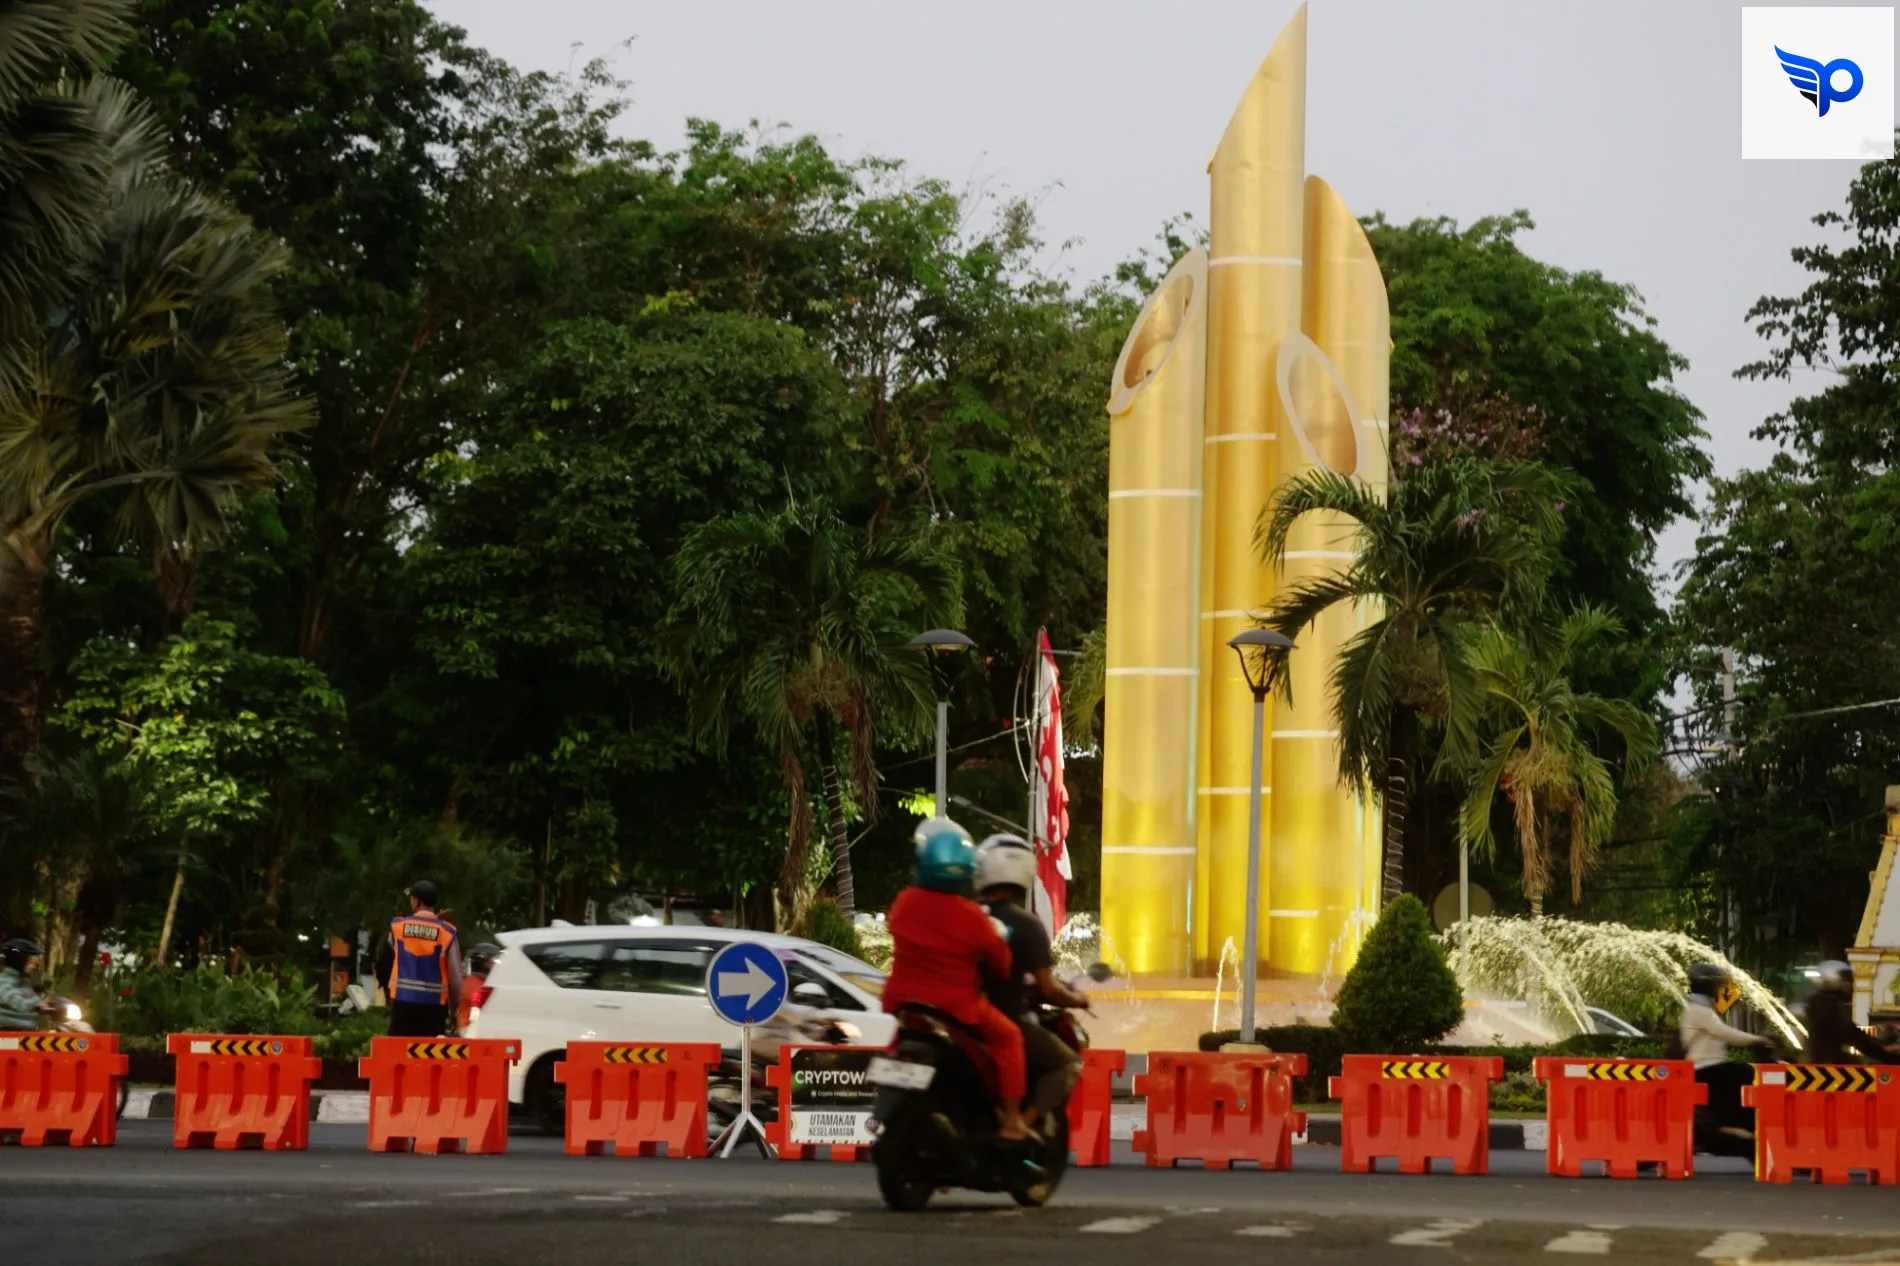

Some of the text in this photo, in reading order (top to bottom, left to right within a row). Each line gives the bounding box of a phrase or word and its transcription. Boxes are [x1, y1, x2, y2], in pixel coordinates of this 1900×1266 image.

[795, 1070, 866, 1085] CRYPTOW
[810, 1113, 856, 1126] UTAMAKAN
[808, 1127, 855, 1137] KESELAMATAN
